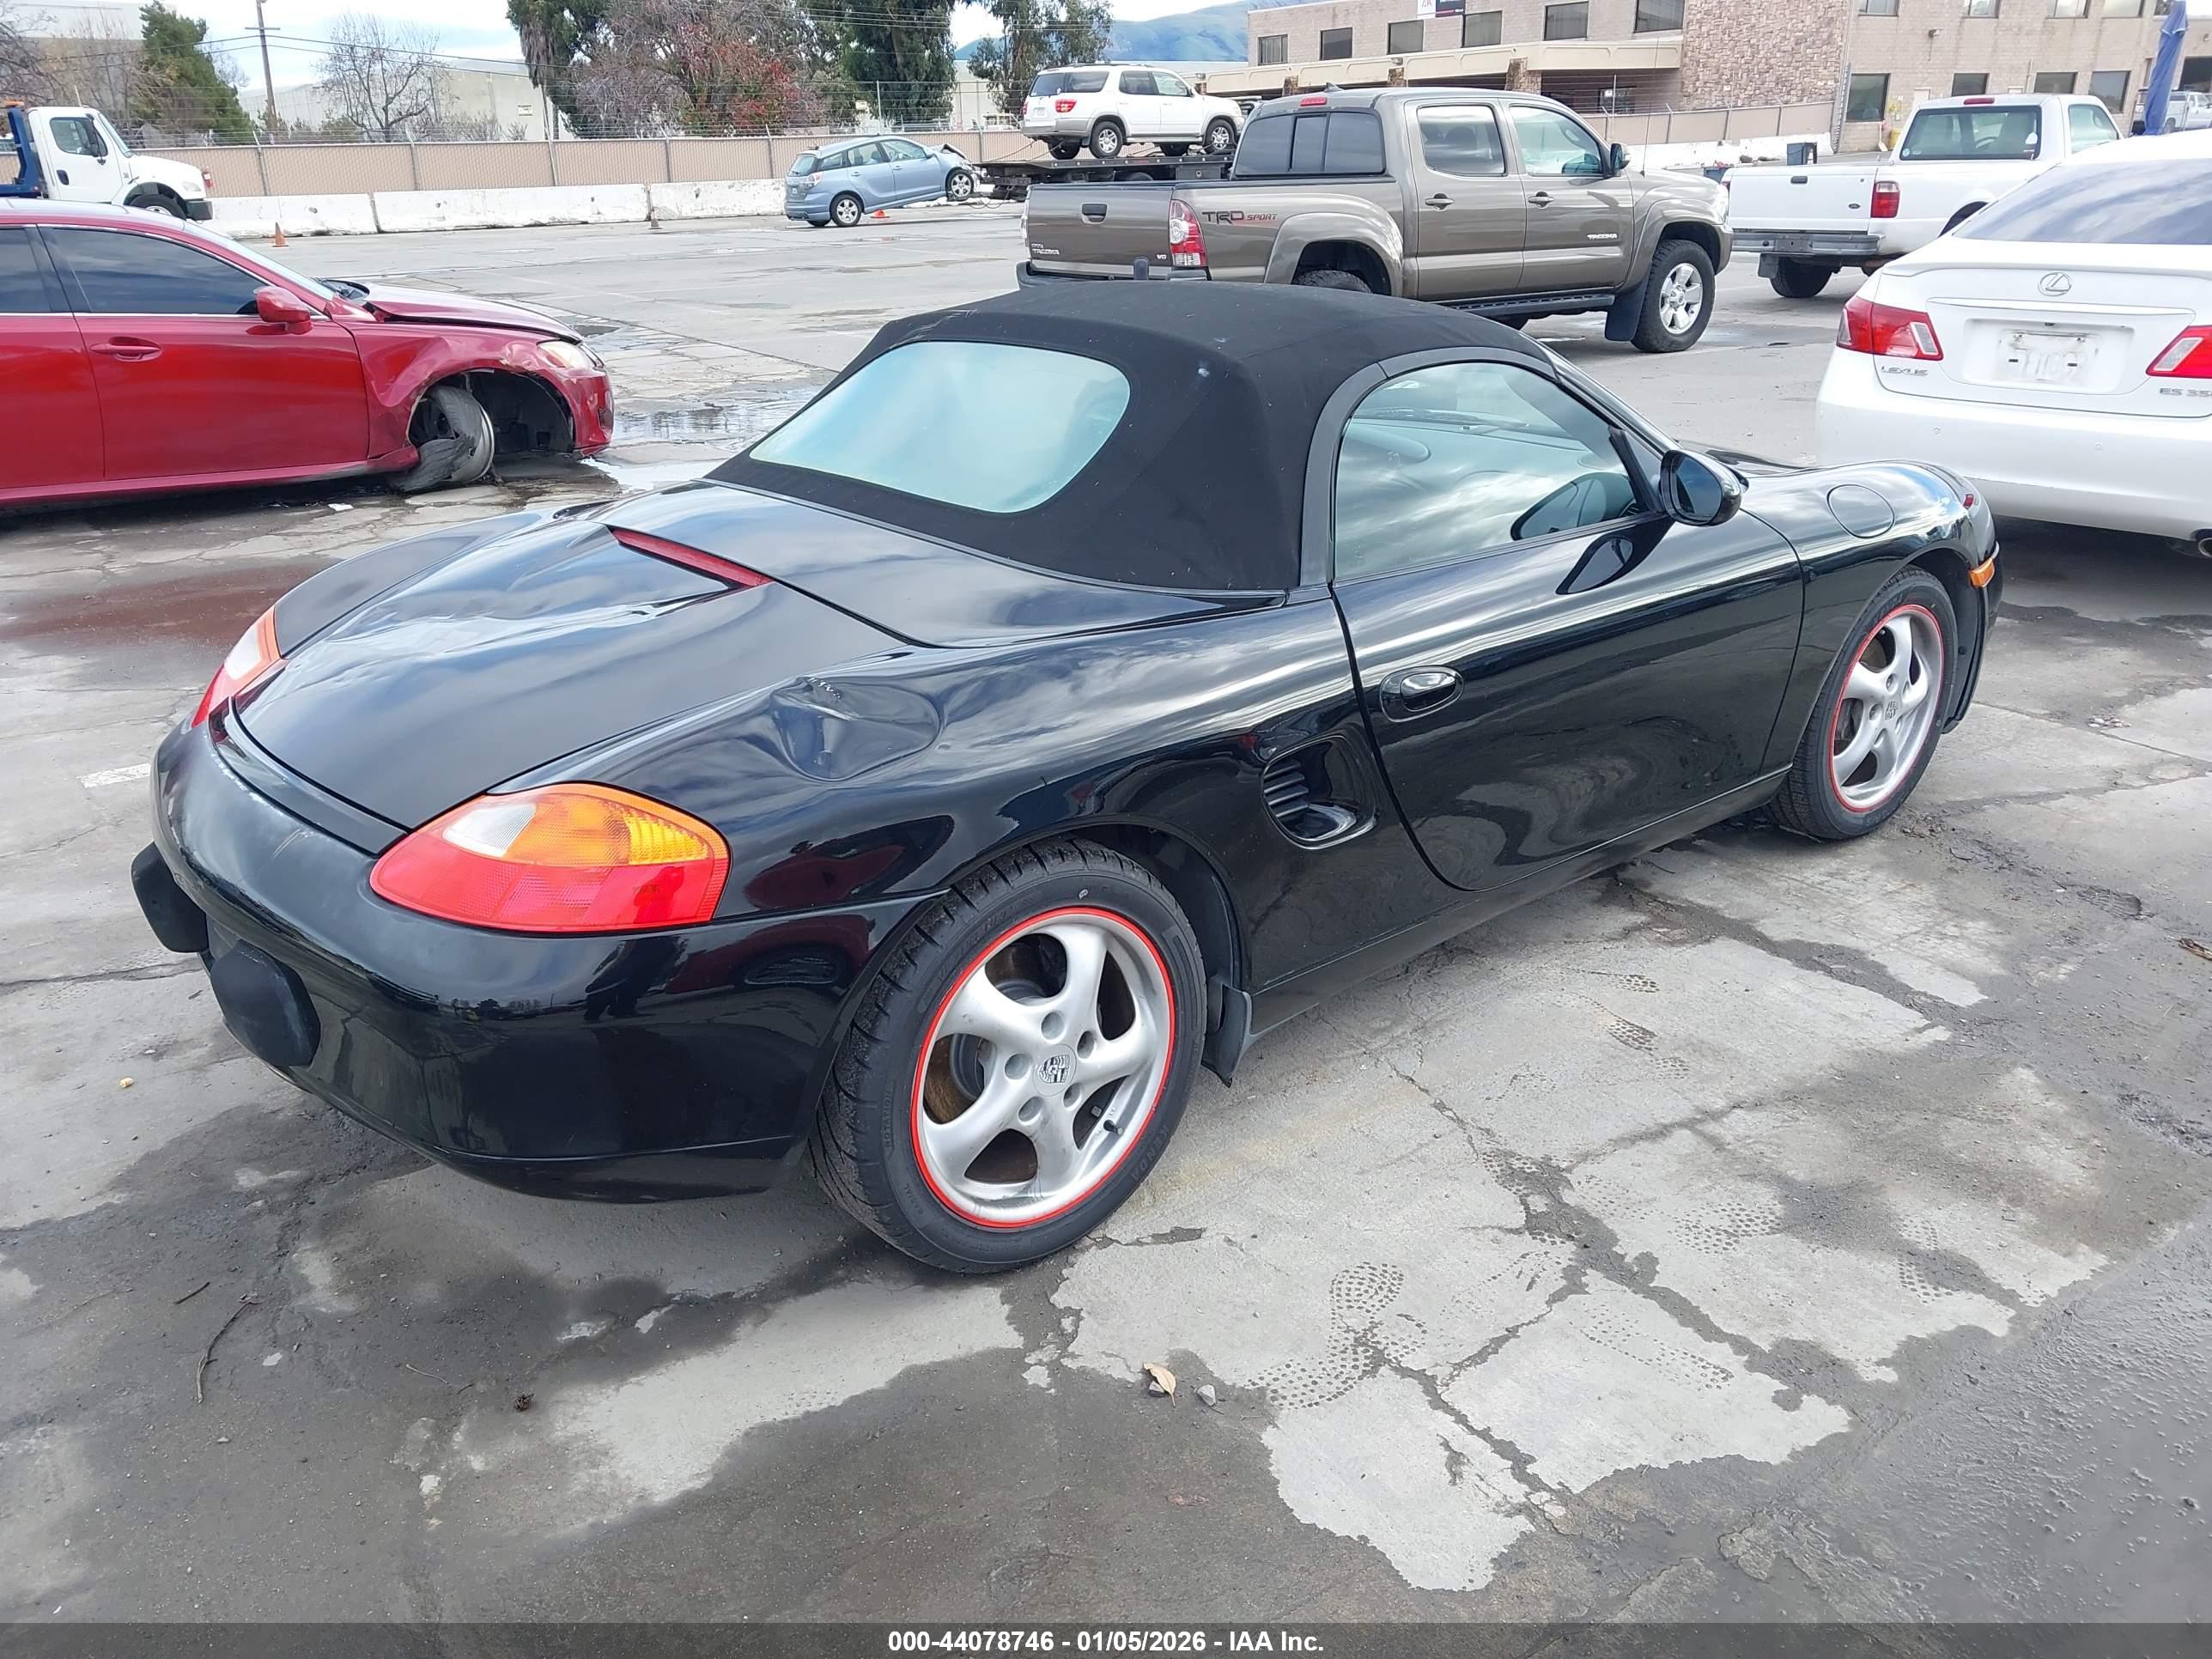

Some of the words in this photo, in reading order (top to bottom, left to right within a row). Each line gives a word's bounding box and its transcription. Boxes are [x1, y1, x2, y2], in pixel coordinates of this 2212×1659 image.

[1201, 210, 1244, 225] TRD
[1881, 366, 1929, 376] LEXUS
[2160, 387, 2184, 396] ES
[2186, 389, 2212, 398] 35
[1131, 1124, 1170, 1181] KENDA
